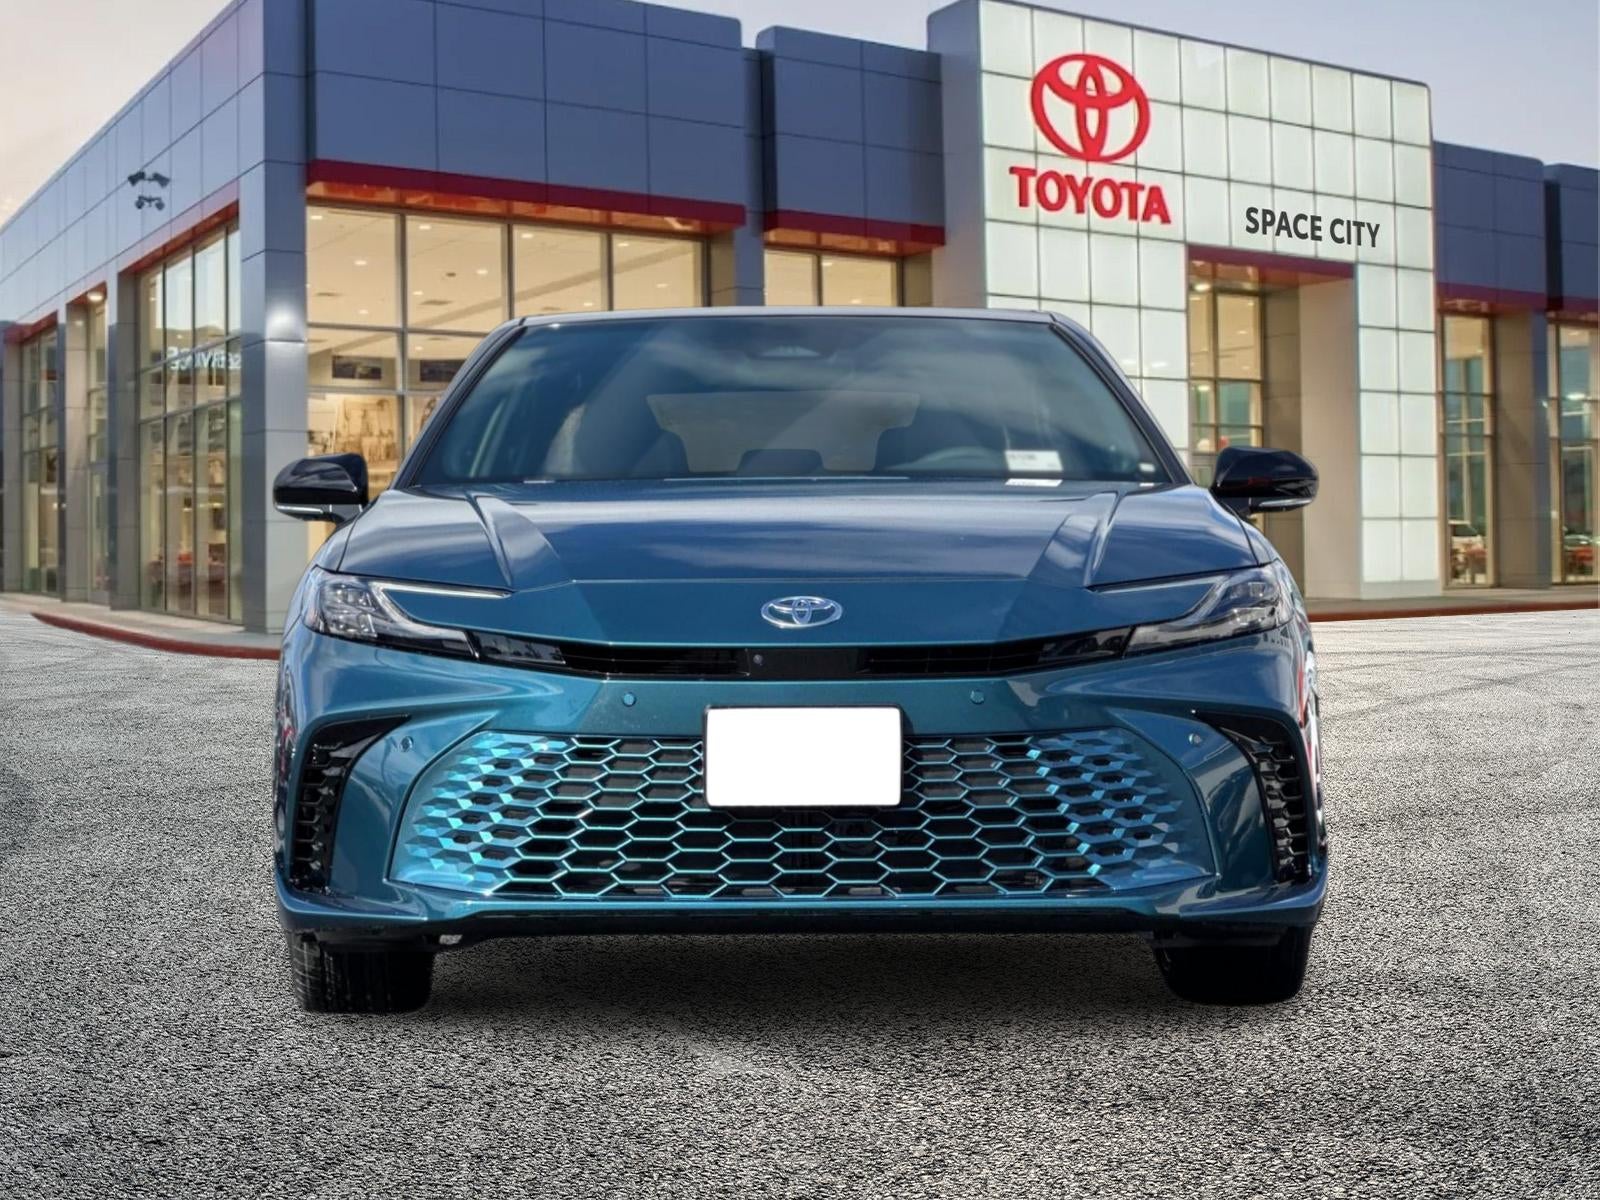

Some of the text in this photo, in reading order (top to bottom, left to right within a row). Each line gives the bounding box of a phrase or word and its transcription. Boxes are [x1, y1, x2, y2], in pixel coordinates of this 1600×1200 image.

[1009, 166, 1171, 225] TOYOTA
[1245, 206, 1381, 248] SPACE CITY
